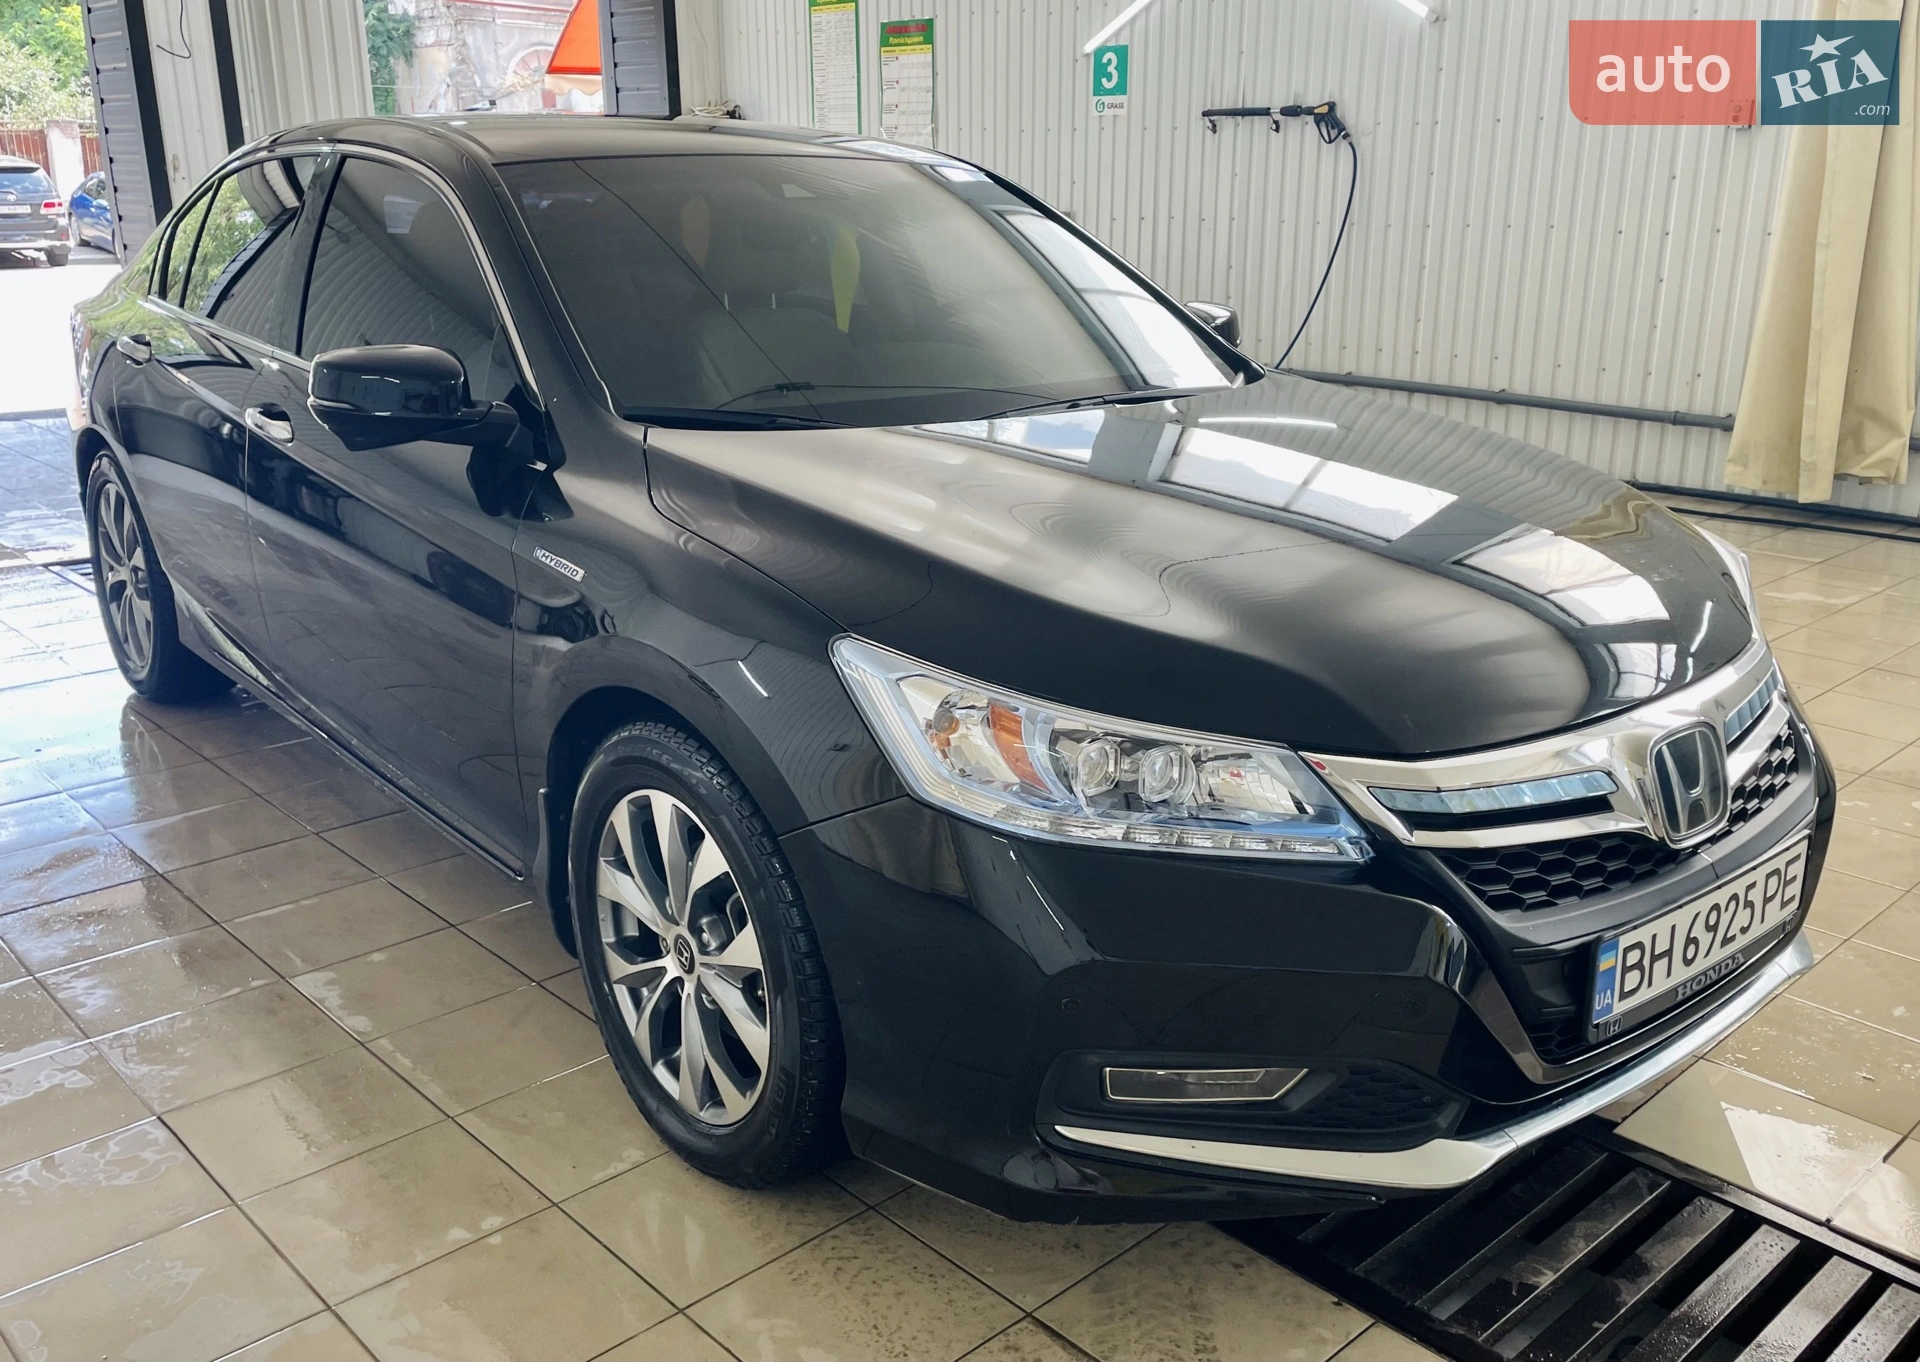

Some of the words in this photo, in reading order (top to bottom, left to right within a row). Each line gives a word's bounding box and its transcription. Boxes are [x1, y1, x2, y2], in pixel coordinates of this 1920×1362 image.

[1101, 51, 1119, 89] 3
[1106, 102, 1125, 110] GRASS
[540, 552, 579, 578] HYBRID
[1618, 924, 1676, 1003] BH
[1682, 881, 1757, 968] 6925
[1760, 853, 1802, 924] PE
[1675, 952, 1746, 1001] HONDA
[1595, 989, 1613, 1010] UA
